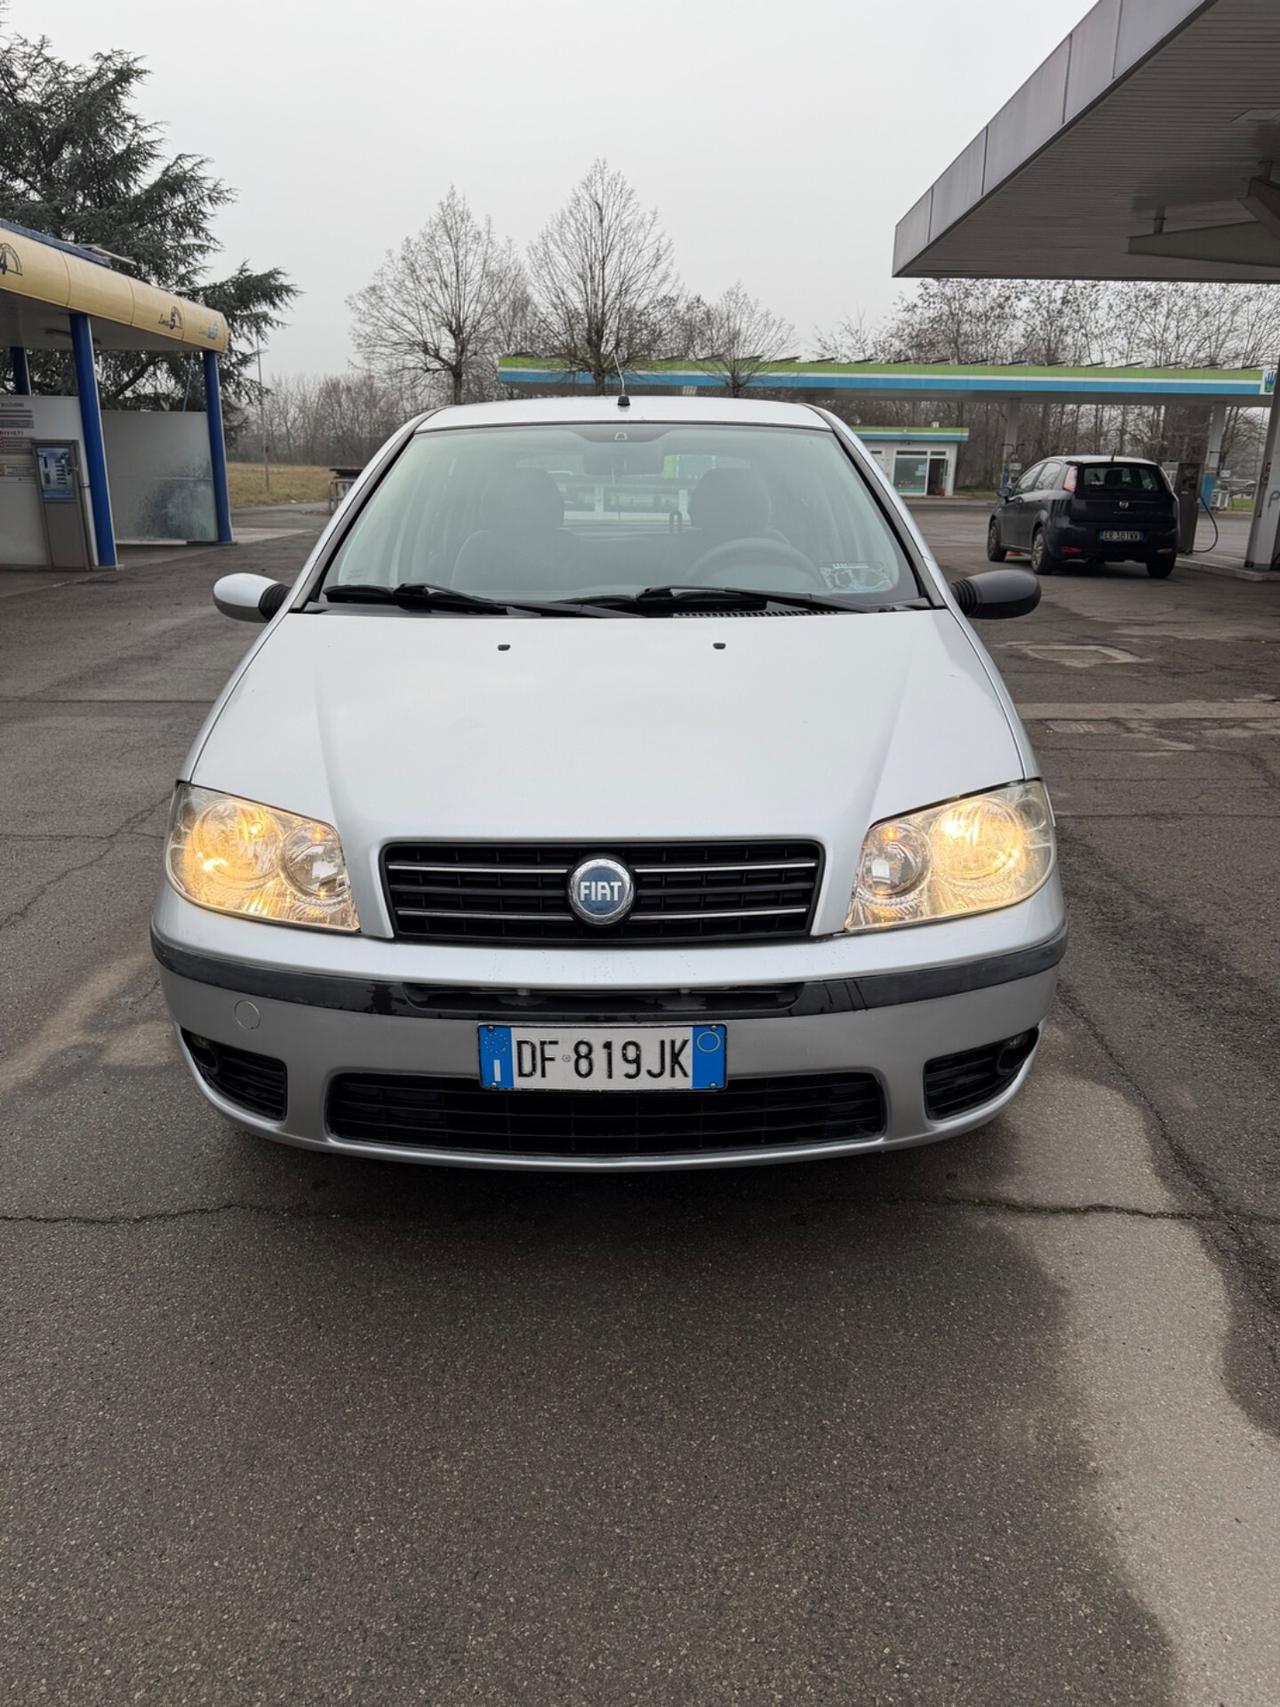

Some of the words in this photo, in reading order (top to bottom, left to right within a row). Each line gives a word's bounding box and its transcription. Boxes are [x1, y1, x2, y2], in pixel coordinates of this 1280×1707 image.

[169, 311, 176, 330] 5
[580, 881, 622, 901] FIAT
[516, 1039, 559, 1079] DF
[573, 1039, 690, 1080] 819JK
